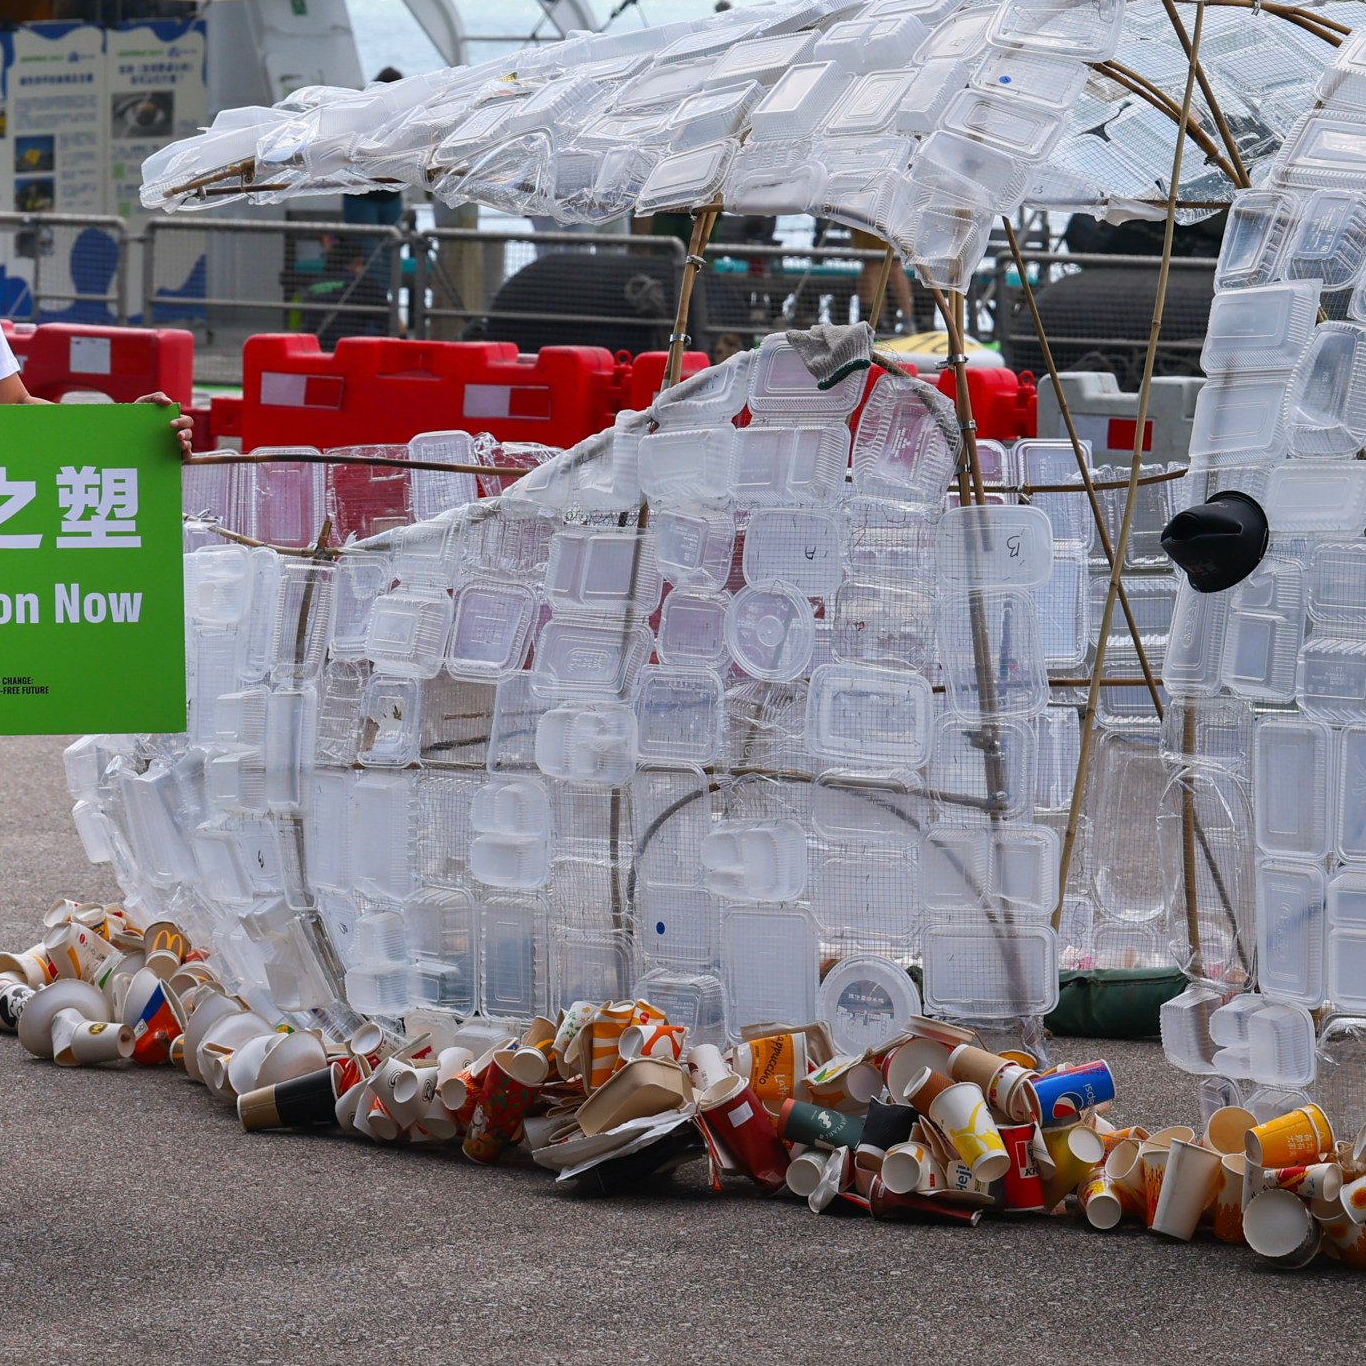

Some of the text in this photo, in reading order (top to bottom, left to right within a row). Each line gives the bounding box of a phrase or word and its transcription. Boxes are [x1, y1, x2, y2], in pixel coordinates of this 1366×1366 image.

[54, 582, 143, 624] Now
[21, 685, 49, 694] FUTURE
[758, 1034, 789, 1085] appuccino
[1082, 1083, 1096, 1106] epsi
[954, 1164, 973, 1191] Hej!
[1024, 1167, 1039, 1177] KF
